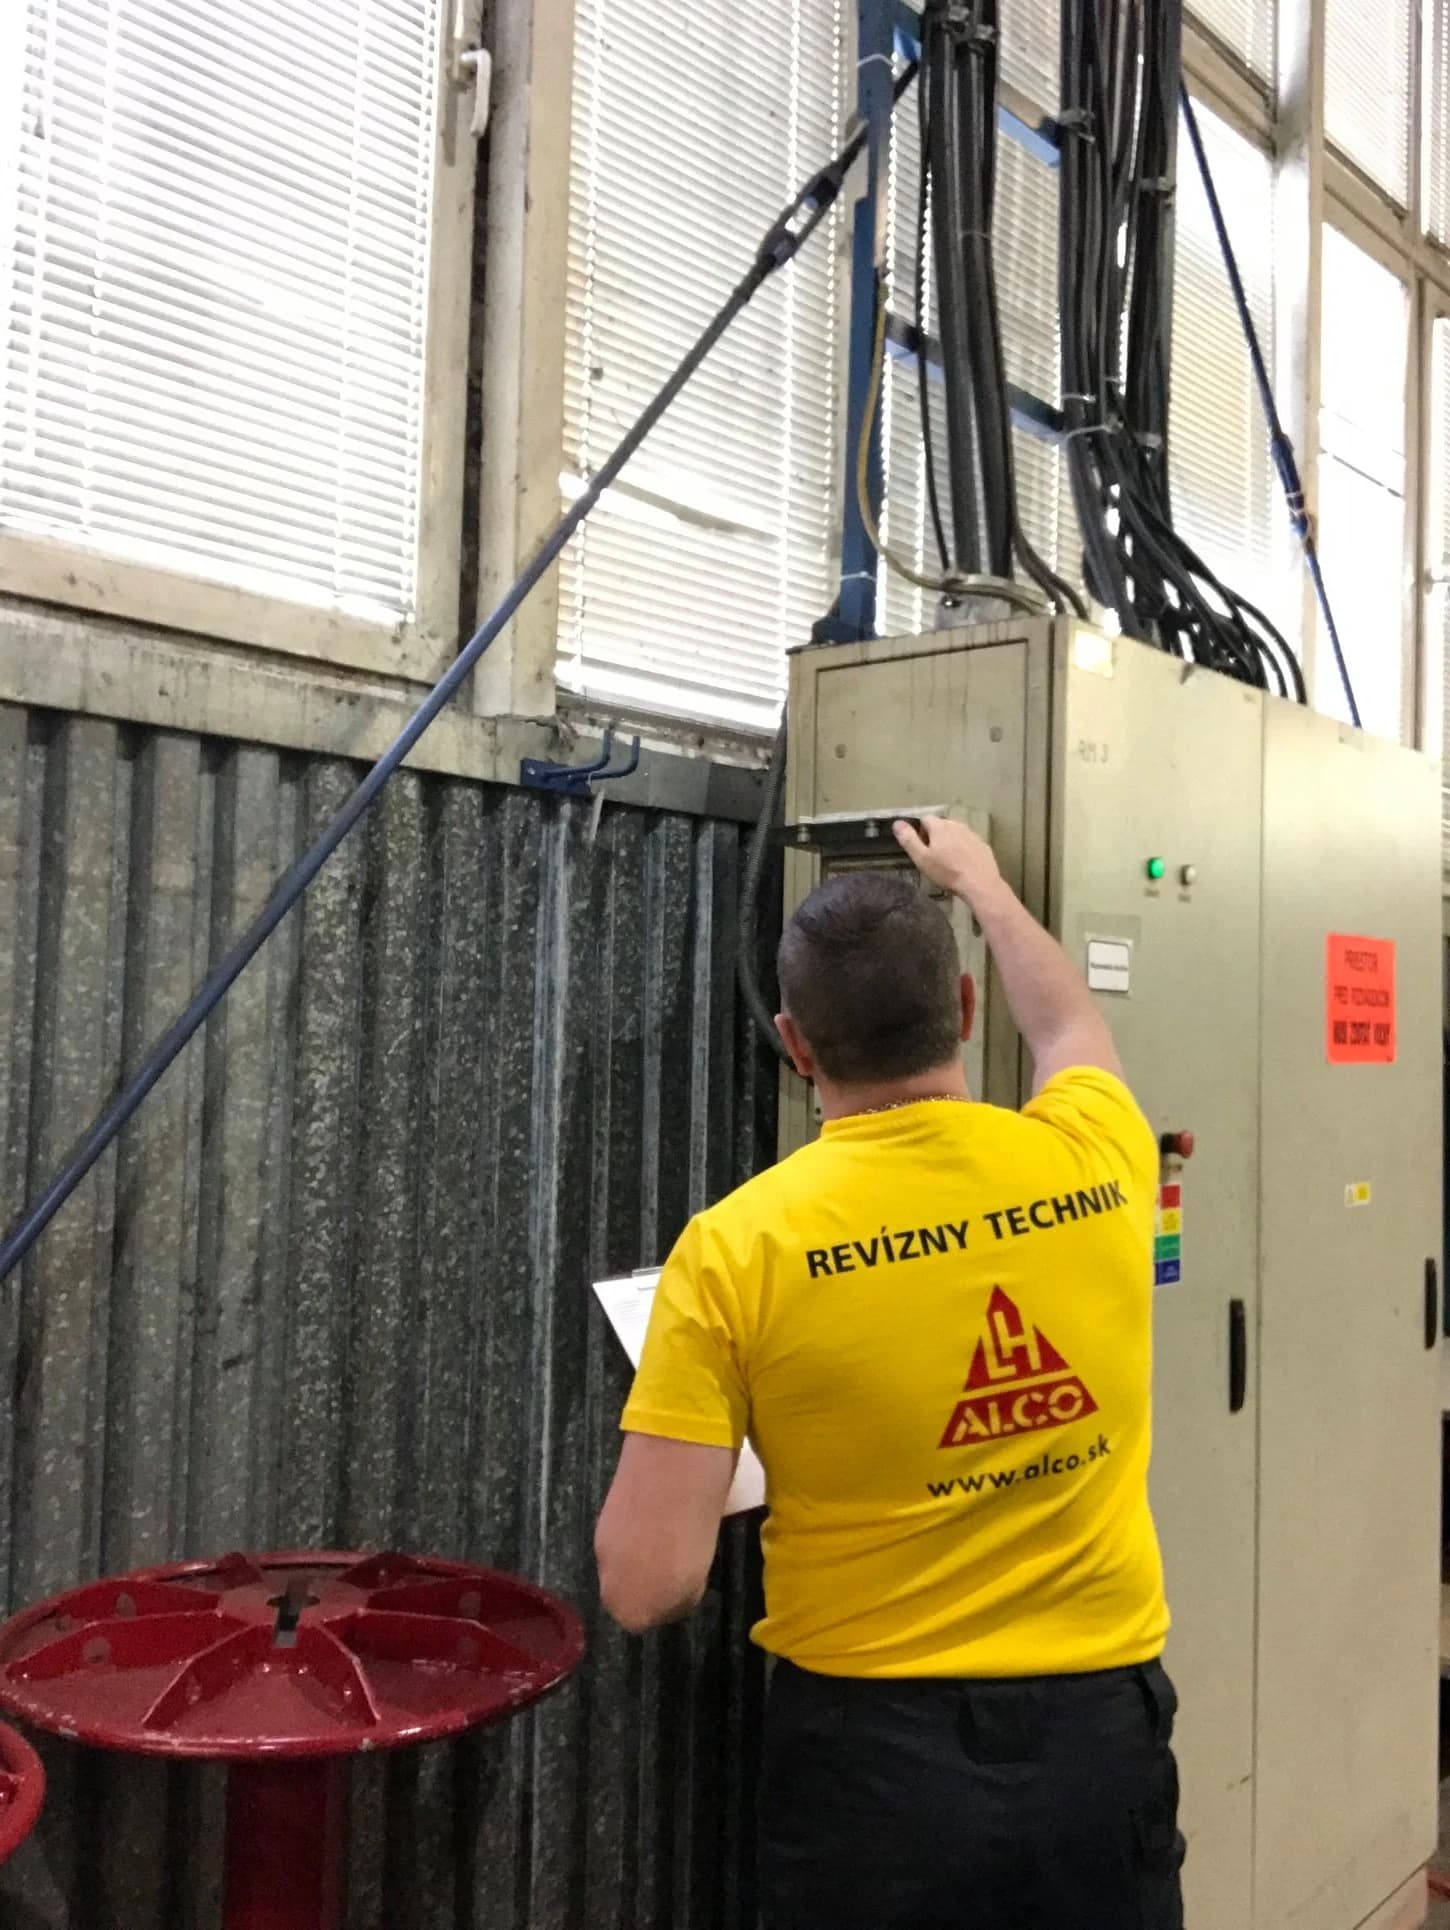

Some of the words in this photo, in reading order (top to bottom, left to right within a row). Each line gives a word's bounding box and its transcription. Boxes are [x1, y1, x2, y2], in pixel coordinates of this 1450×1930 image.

[806, 1220, 970, 1279] REVÍZNY
[982, 1180, 1128, 1240] TECHNIK
[951, 1384, 1083, 1442] ALCO
[926, 1433, 1111, 1498] www.alco.sk
